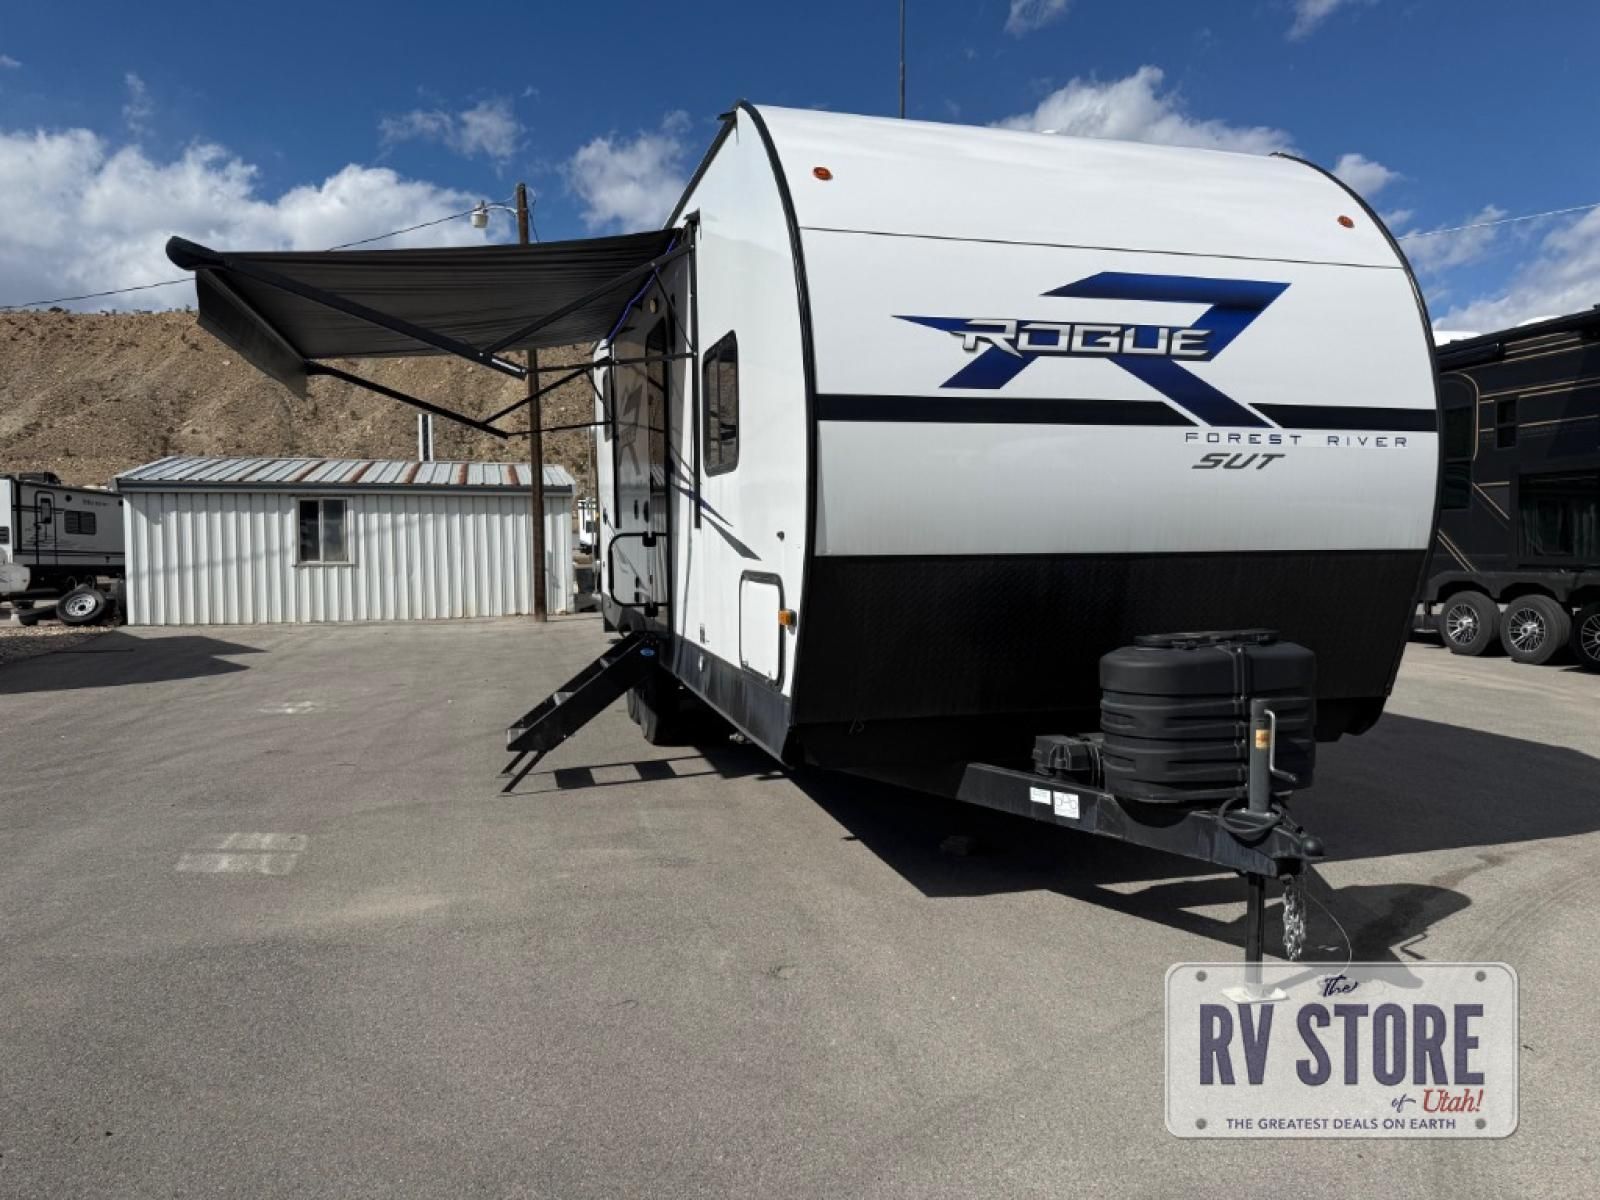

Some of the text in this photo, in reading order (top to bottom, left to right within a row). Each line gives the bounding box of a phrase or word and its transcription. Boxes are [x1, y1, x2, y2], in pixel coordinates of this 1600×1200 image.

[952, 318, 1217, 358] ROGUE
[1185, 431, 1408, 448] FOREST RIVER
[1191, 452, 1287, 471] SUT
